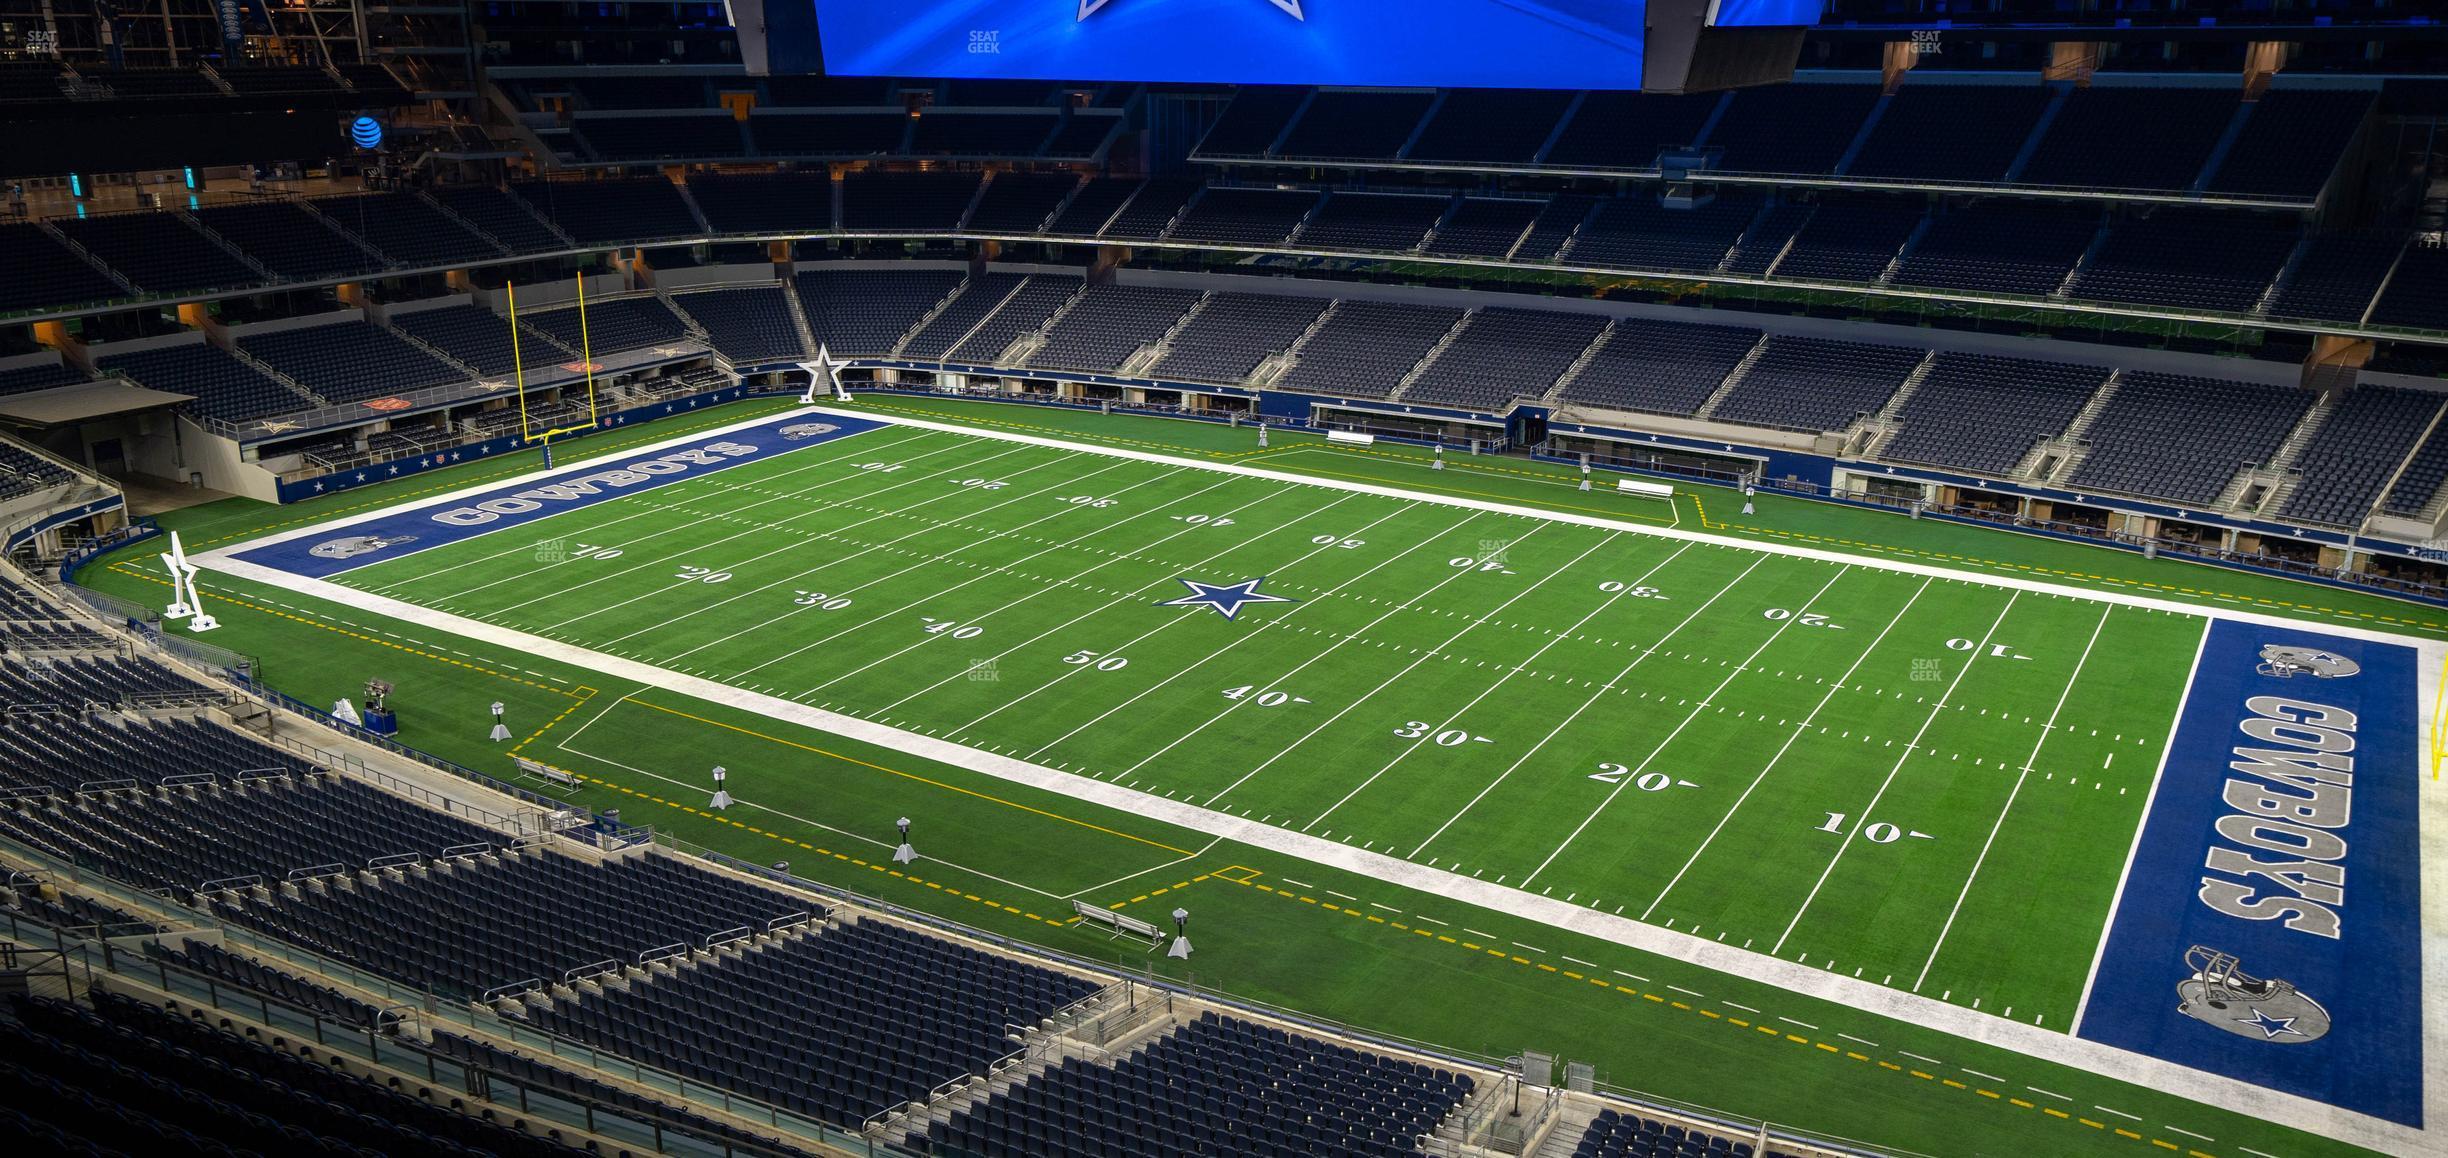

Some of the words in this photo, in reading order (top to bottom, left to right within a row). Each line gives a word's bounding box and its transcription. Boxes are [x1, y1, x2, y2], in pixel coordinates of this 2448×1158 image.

[431, 442, 758, 526] COWBOYS
[571, 546, 624, 560] 10
[674, 567, 733, 584] 20
[1598, 581, 1659, 598] 30
[795, 592, 852, 611] 30
[1763, 608, 1830, 627] 20
[923, 620, 984, 640] 40
[1945, 638, 2013, 658] 10
[1062, 650, 1129, 671] 50
[1222, 685, 1289, 707] 40
[1393, 721, 1468, 747] 30
[1589, 763, 1671, 791] 20
[1814, 812, 1902, 843] 10
[2198, 695, 2358, 940] COWBOYS
